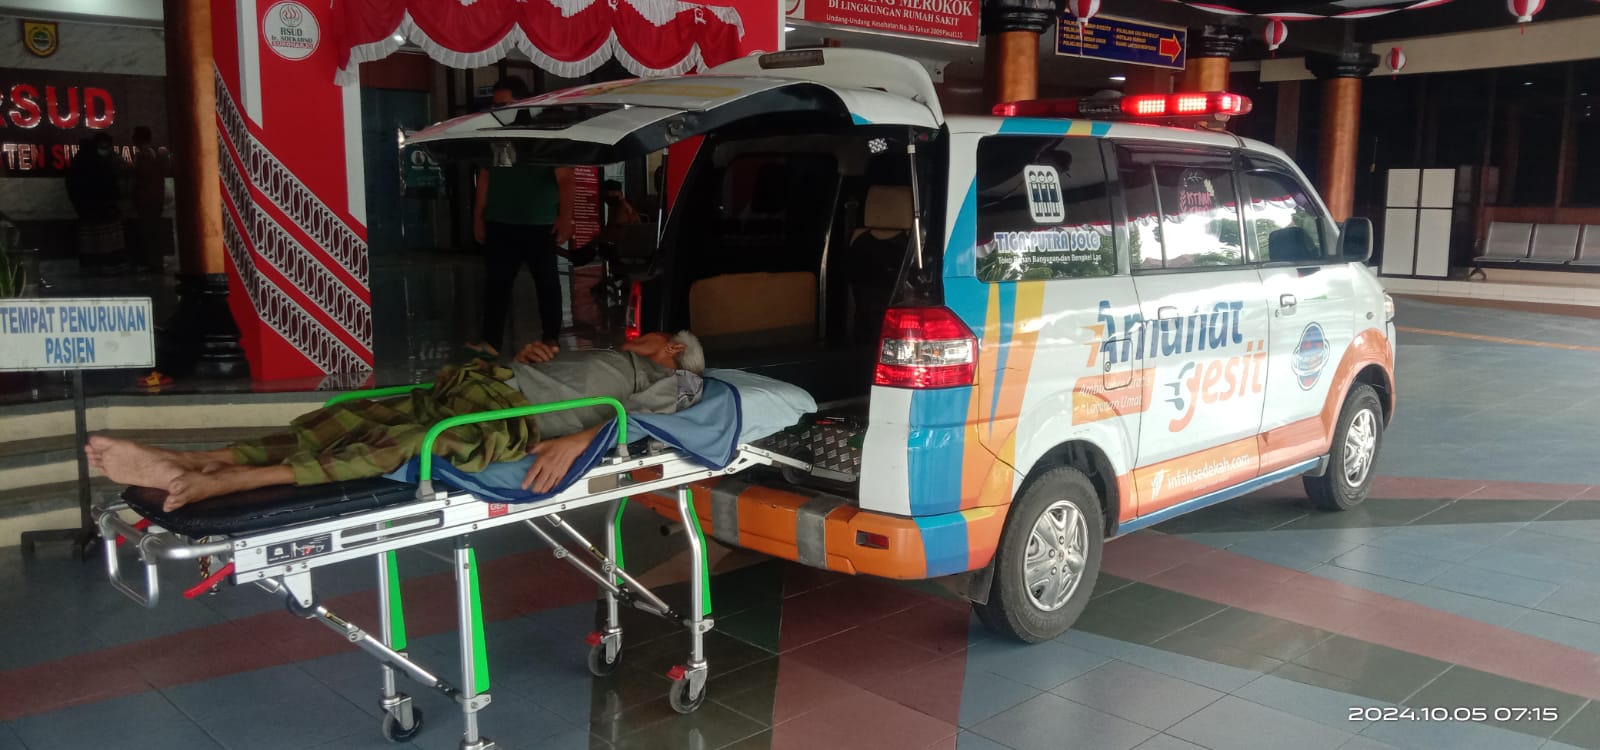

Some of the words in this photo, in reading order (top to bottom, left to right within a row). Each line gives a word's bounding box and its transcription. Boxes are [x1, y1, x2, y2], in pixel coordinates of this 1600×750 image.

[829, 0, 839, 8] DI
[841, 1, 901, 17] LINGKUNGAN
[903, 9, 934, 22] RUMAH
[935, 15, 959, 26] SAKIT
[899, 0, 973, 16] MEROKOK
[280, 27, 303, 37] RSUD
[0, 82, 116, 129] SUD
[0, 144, 45, 170] TEN
[1028, 231, 1070, 252] PUTRA
[0, 306, 55, 334] TEMPAT
[59, 305, 146, 333] PENURUNAN
[45, 337, 95, 364] PASIEN
[1167, 454, 1250, 489] infaksedekah.com
